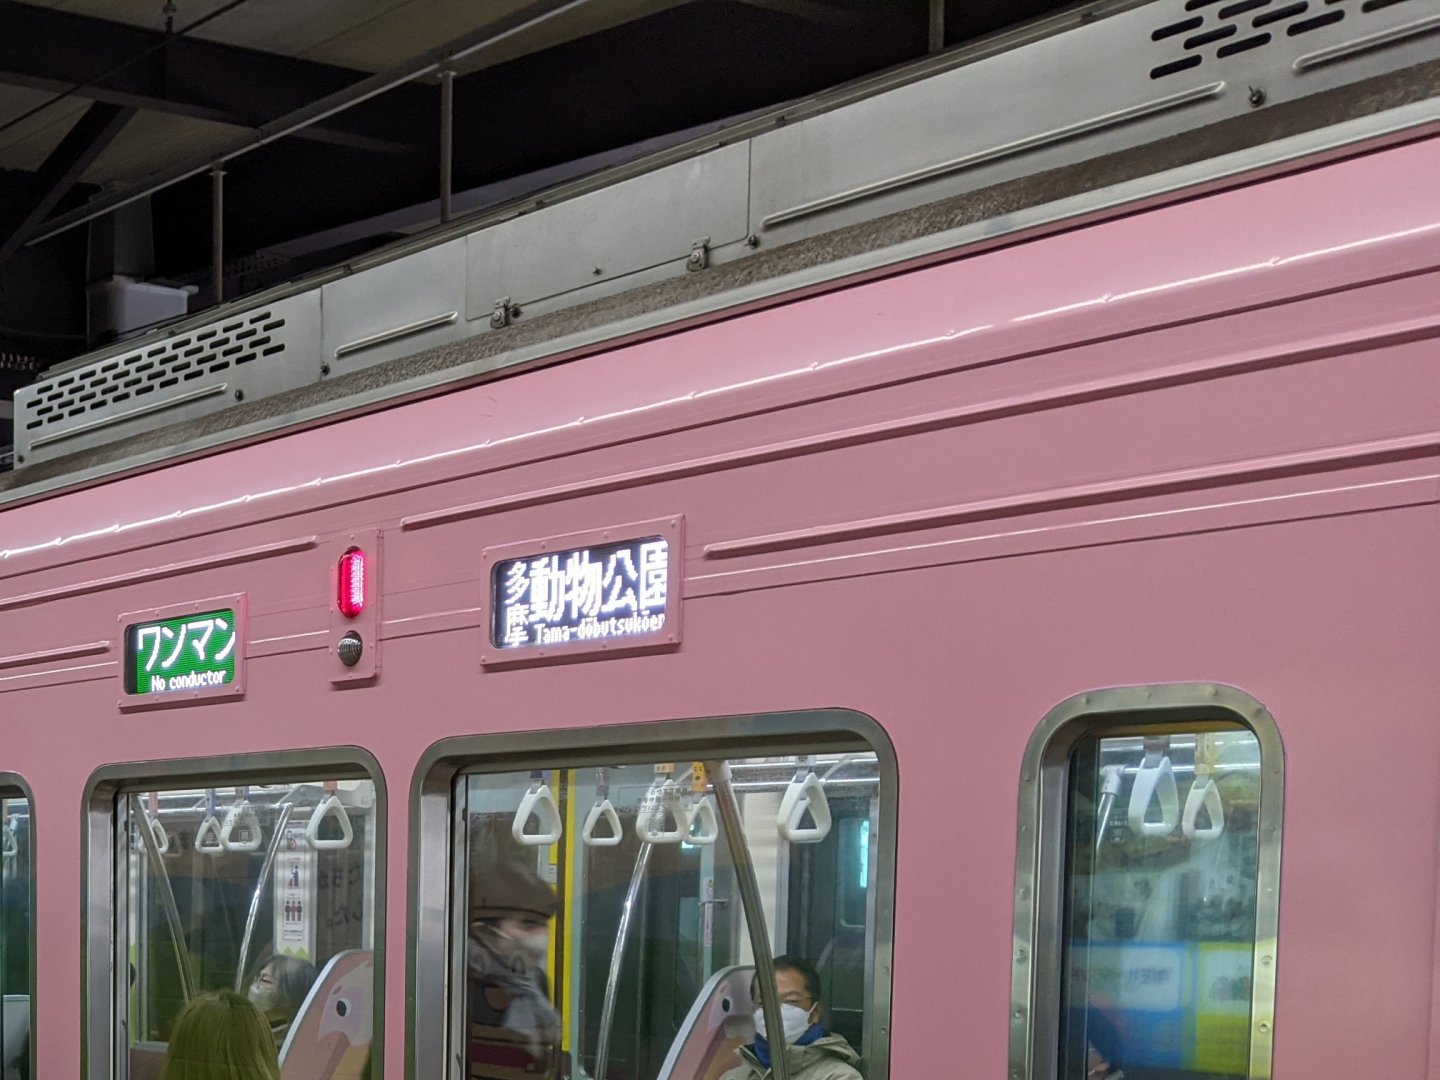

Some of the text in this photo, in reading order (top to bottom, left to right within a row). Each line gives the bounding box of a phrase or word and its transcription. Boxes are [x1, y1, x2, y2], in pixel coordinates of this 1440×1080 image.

[138, 618, 235, 671] ワンマン
[151, 670, 226, 691] No conductor
